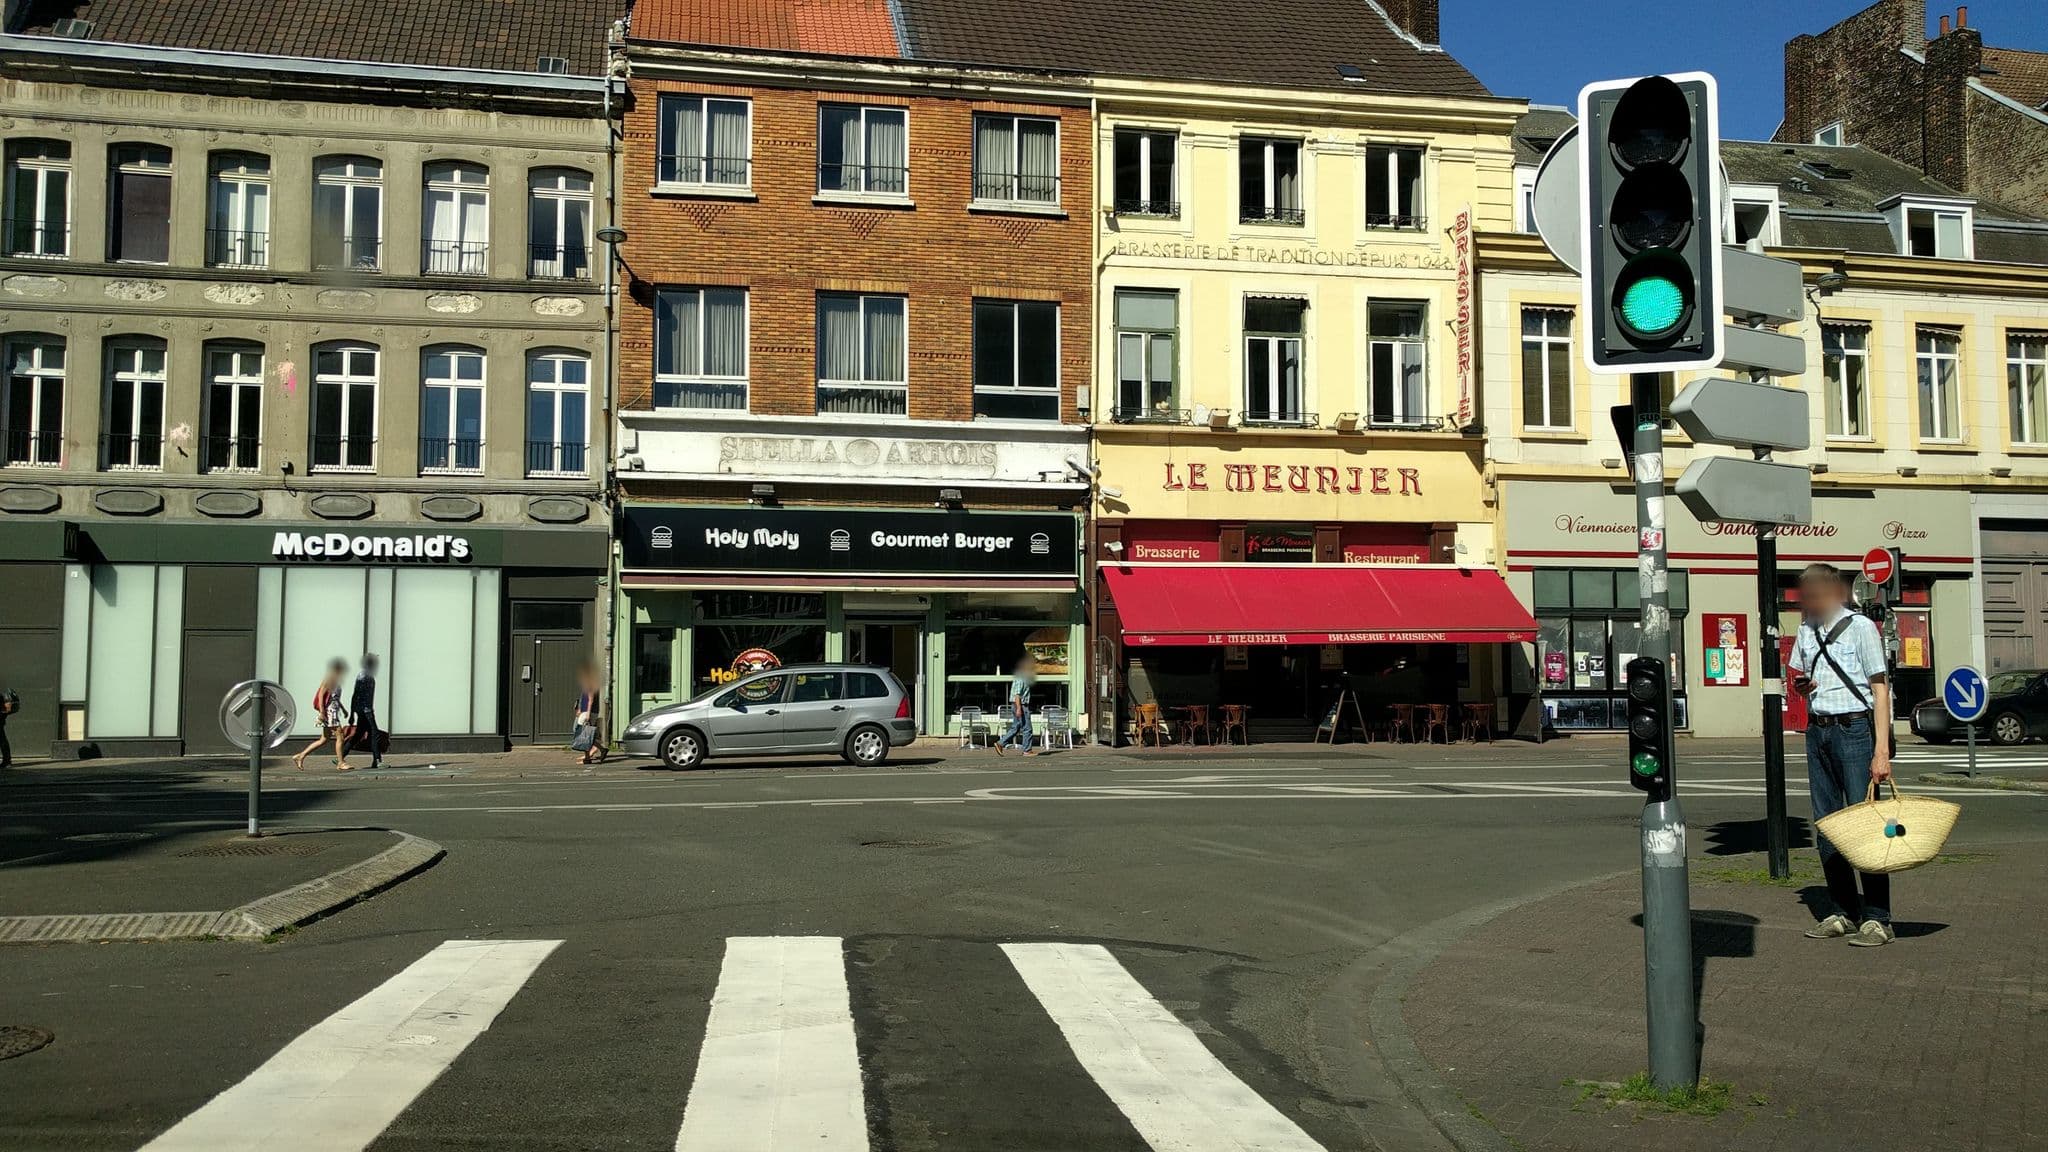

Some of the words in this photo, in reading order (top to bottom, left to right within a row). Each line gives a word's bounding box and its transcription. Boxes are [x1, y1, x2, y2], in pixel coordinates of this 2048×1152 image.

[1117, 240, 1210, 260] BRASSERIE
[1218, 246, 1239, 261] DE
[1246, 245, 1344, 266] TRADITION
[1347, 252, 1408, 268] DEPUIS
[1455, 212, 1471, 420] BRASSERIE
[720, 436, 838, 463] STELLA
[885, 440, 998, 466] ARTOIS
[1162, 462, 1209, 492] LE
[1224, 463, 1423, 496] MEUNIER
[1555, 514, 1638, 534] Viennoiser
[1883, 520, 1928, 540] Pizza
[271, 532, 470, 559] McDonald's
[705, 527, 749, 549] Holy
[753, 527, 800, 550] Moly
[871, 530, 950, 548] Gourmet
[955, 532, 1014, 552] Burger
[1135, 544, 1201, 559] Brasserie
[1344, 551, 1420, 564] Restaurant
[1207, 634, 1223, 644] LE
[1228, 634, 1288, 644] MEUNIER
[1328, 633, 1386, 642] BRASSERIE
[1389, 632, 1446, 641] PARISIENNE
